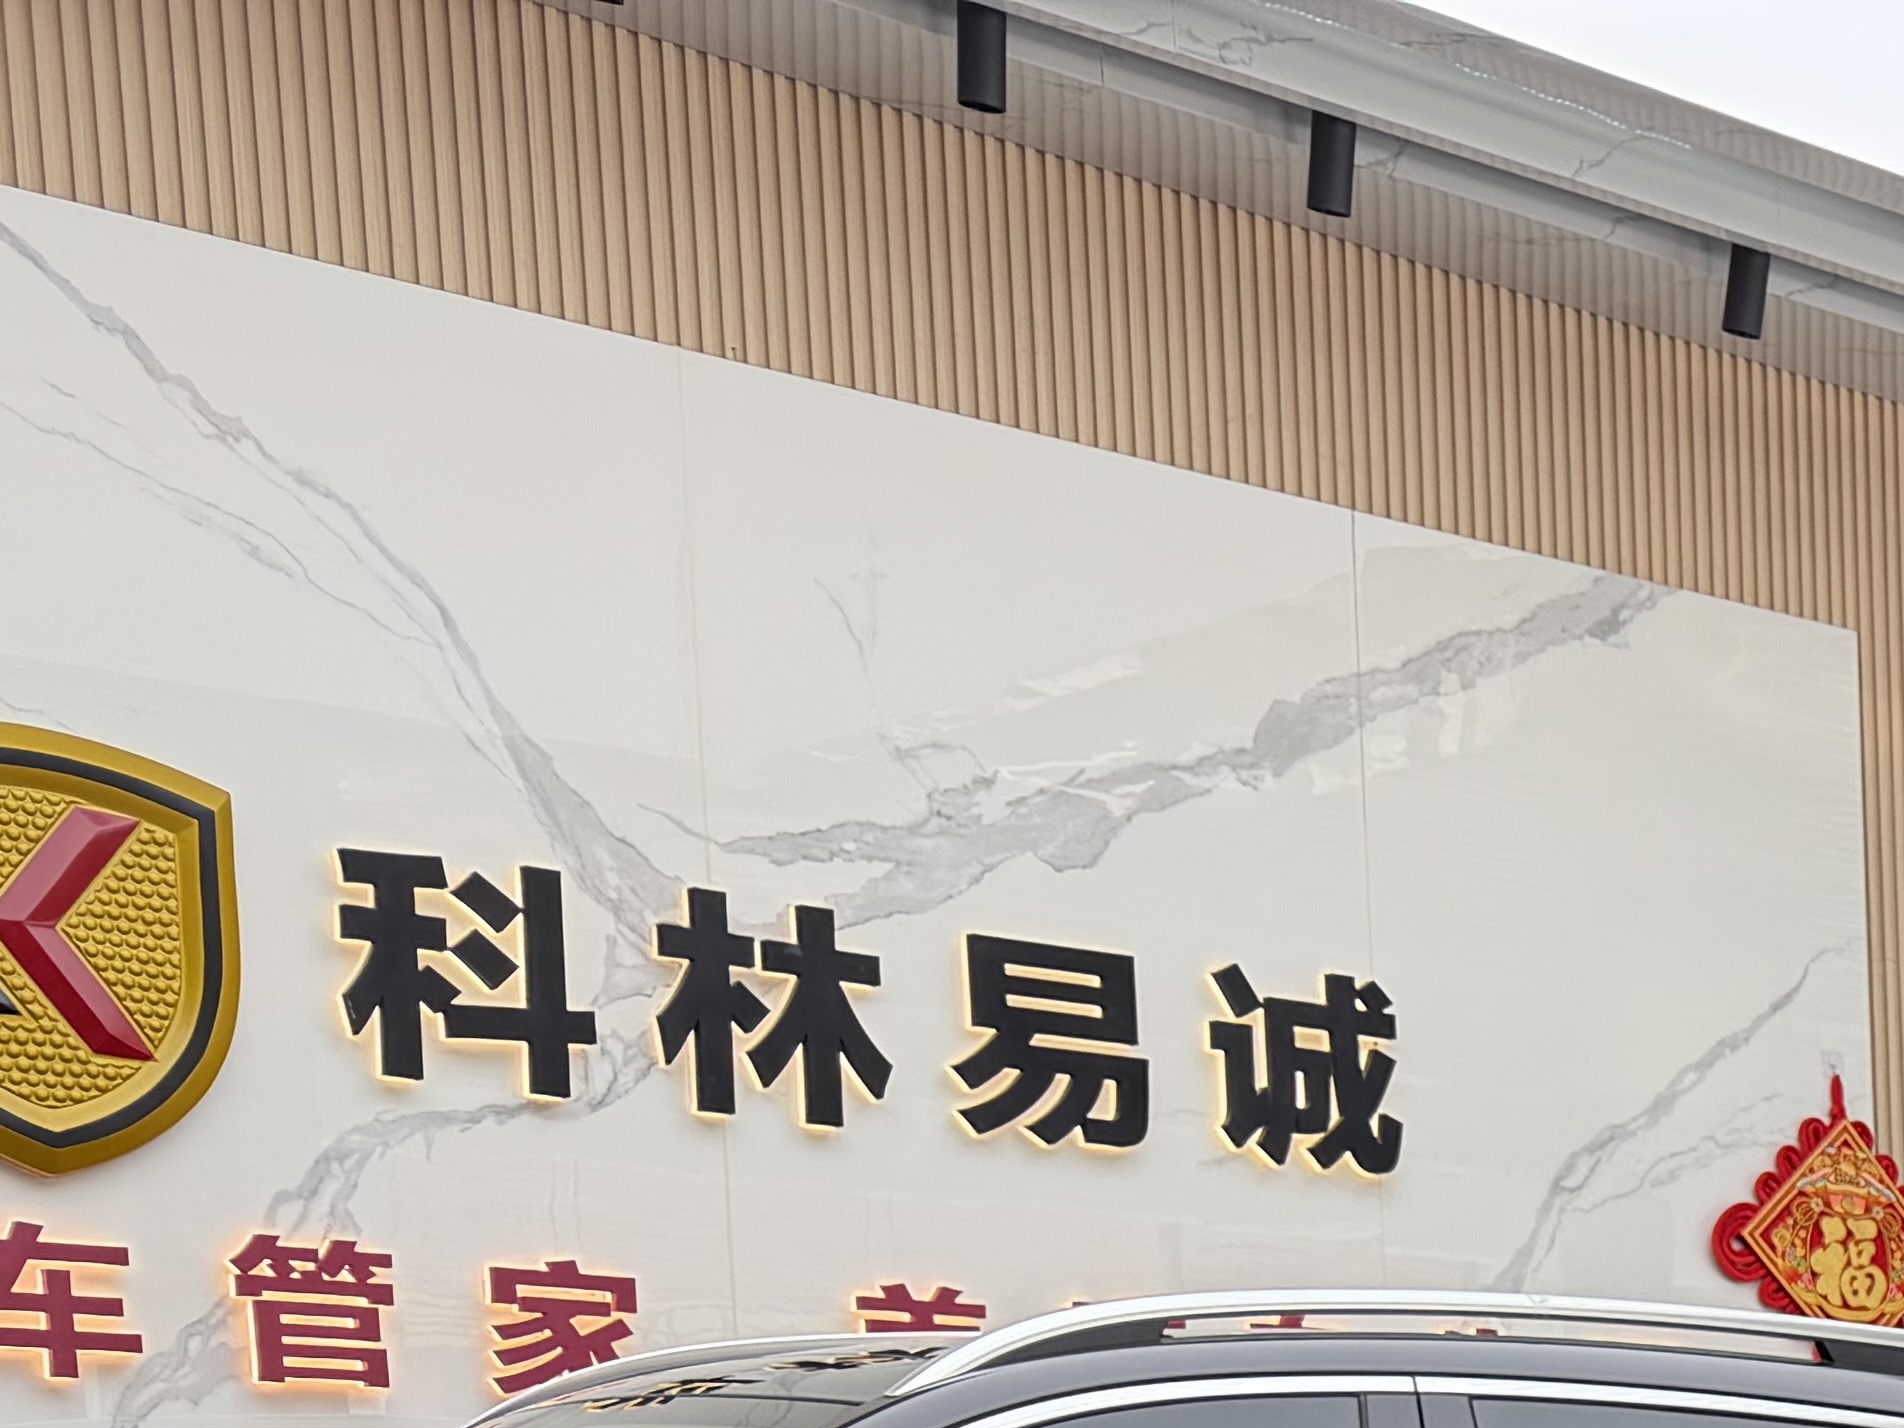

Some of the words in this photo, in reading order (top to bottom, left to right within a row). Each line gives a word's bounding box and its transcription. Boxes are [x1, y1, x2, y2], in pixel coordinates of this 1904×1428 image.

[333, 846, 1405, 1177] 科林易诚
[1810, 1215, 1888, 1311] 福
